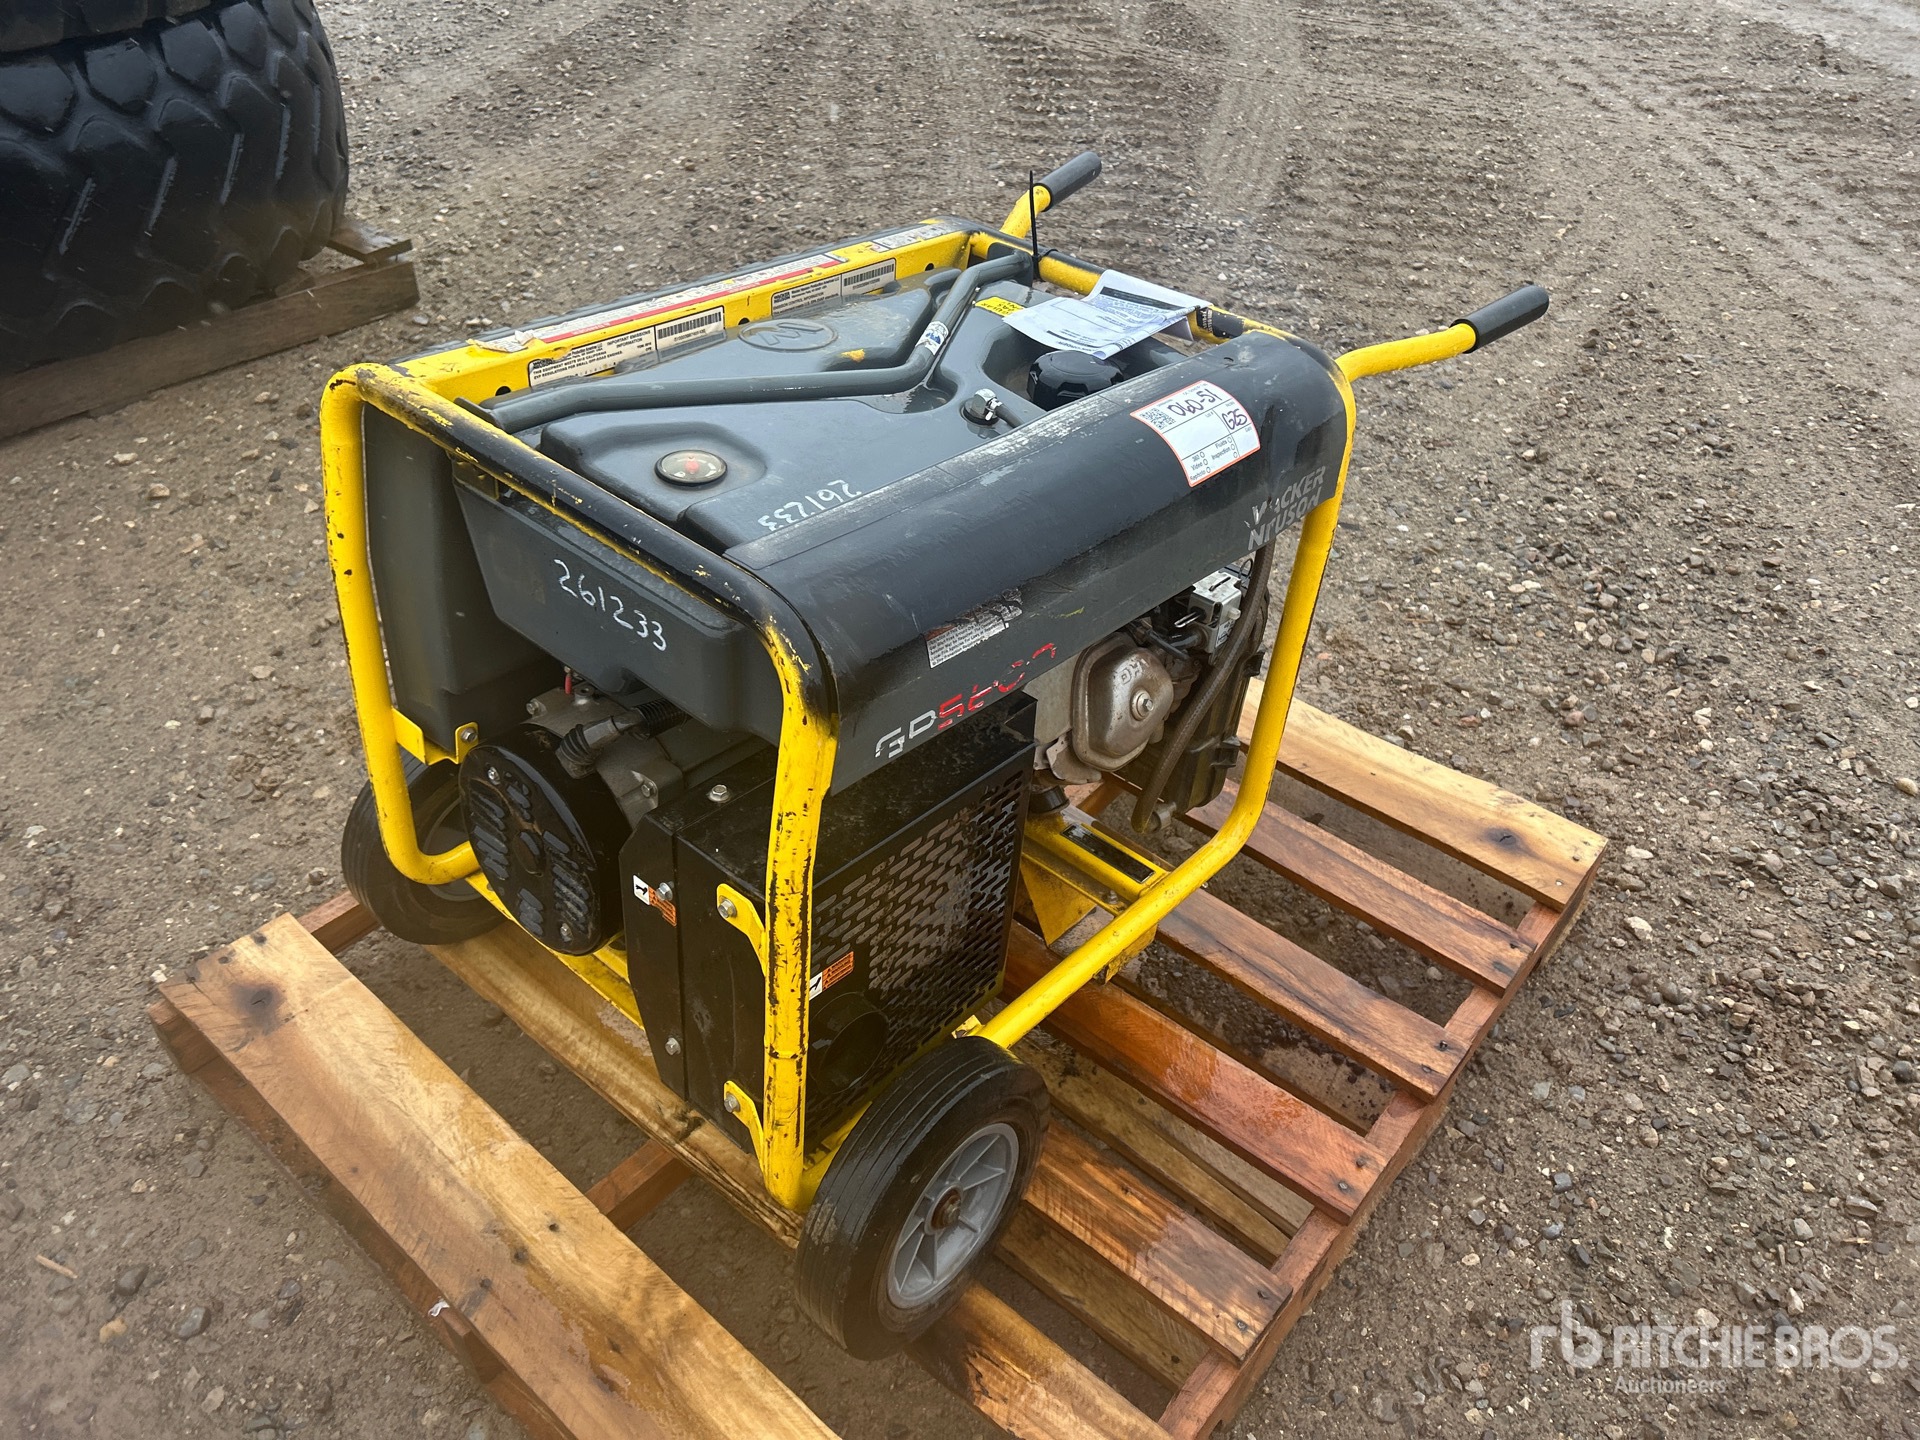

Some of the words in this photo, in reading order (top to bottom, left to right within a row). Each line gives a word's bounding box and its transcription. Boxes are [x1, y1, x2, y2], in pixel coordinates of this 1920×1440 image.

[758, 479, 863, 532] 261233
[1252, 466, 1326, 525] WCKER
[554, 559, 667, 652] 261233
